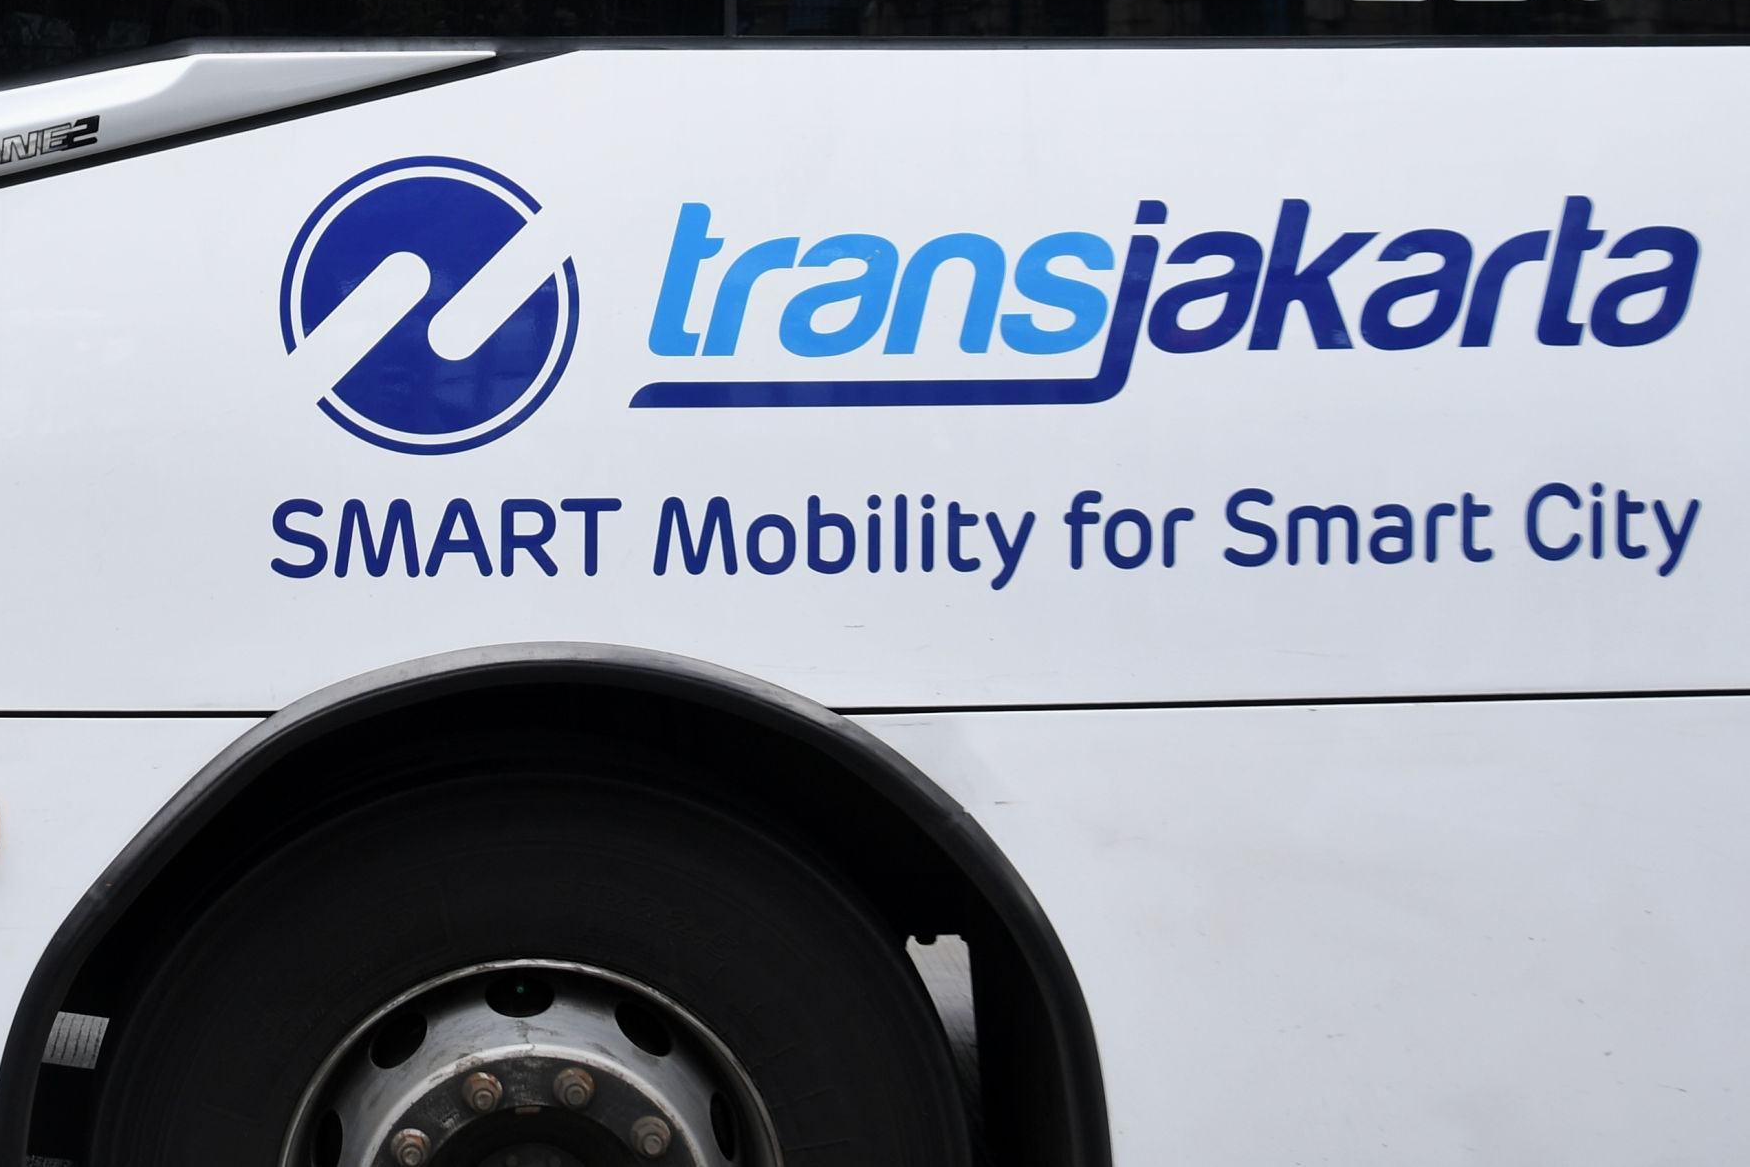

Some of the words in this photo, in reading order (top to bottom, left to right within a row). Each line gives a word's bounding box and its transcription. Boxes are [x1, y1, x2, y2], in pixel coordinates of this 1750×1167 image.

[628, 194, 1701, 409] transjakarta
[270, 497, 622, 579] SMART
[653, 493, 1036, 591] Mobility
[1063, 490, 1195, 570] for
[1223, 488, 1493, 568] Smart
[1526, 482, 1700, 578] City
